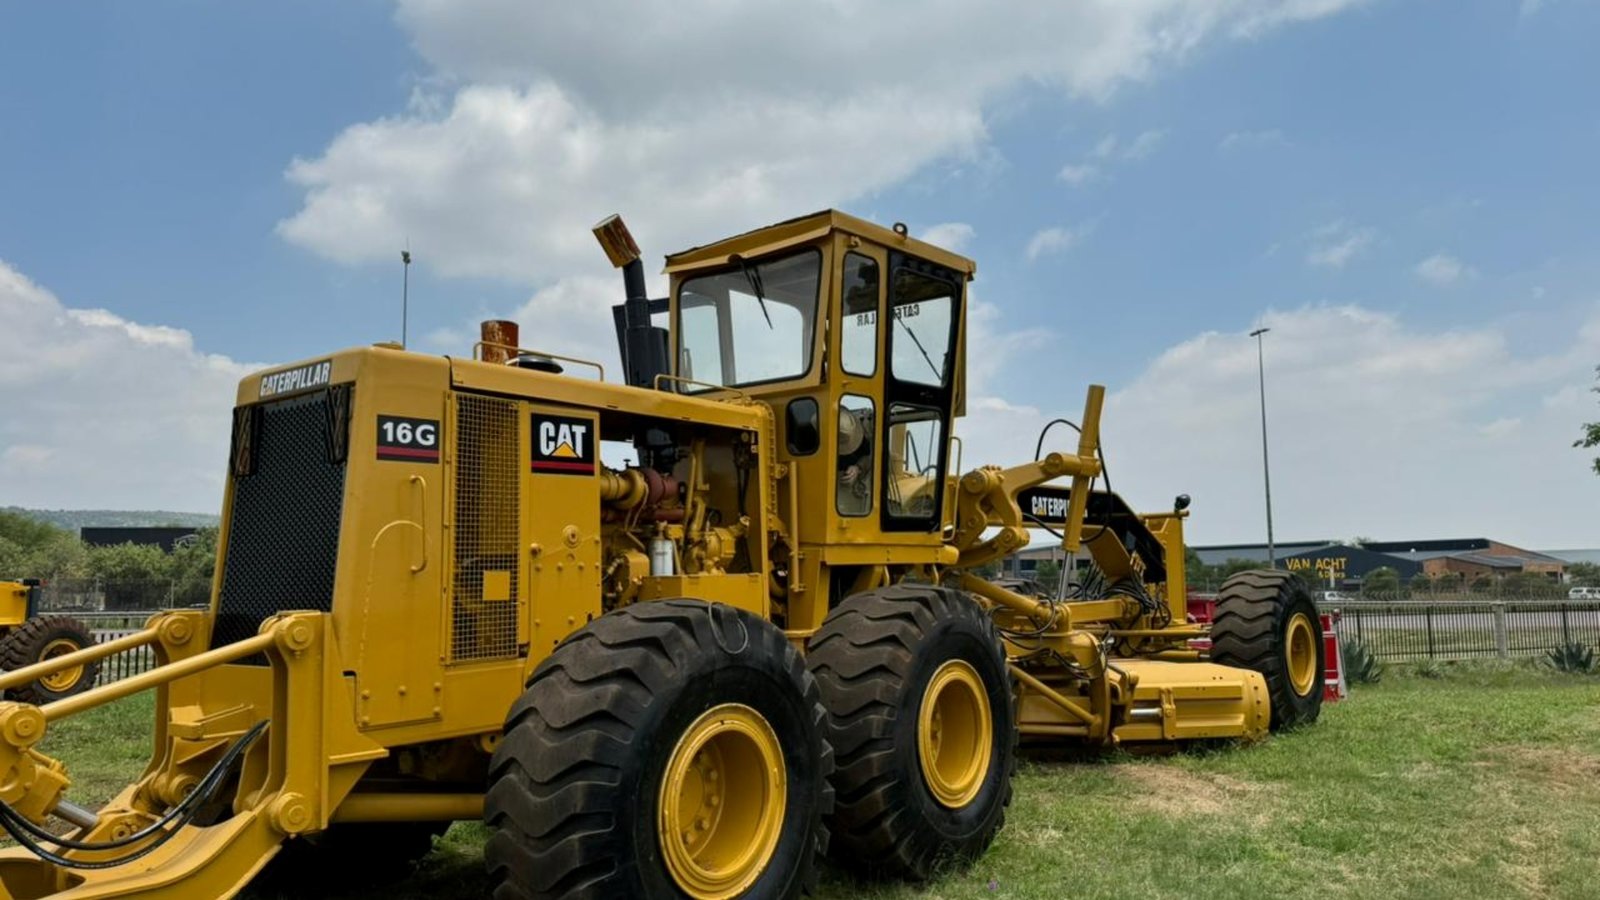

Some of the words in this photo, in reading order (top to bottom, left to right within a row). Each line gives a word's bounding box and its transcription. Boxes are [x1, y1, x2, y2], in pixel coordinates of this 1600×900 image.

[260, 361, 331, 397] CATERPILLAR
[382, 421, 435, 446] 16G
[539, 420, 587, 458] CAT
[1031, 495, 1088, 518] CATERPI
[1285, 558, 1311, 570] VAN
[1315, 557, 1346, 570] ACHT
